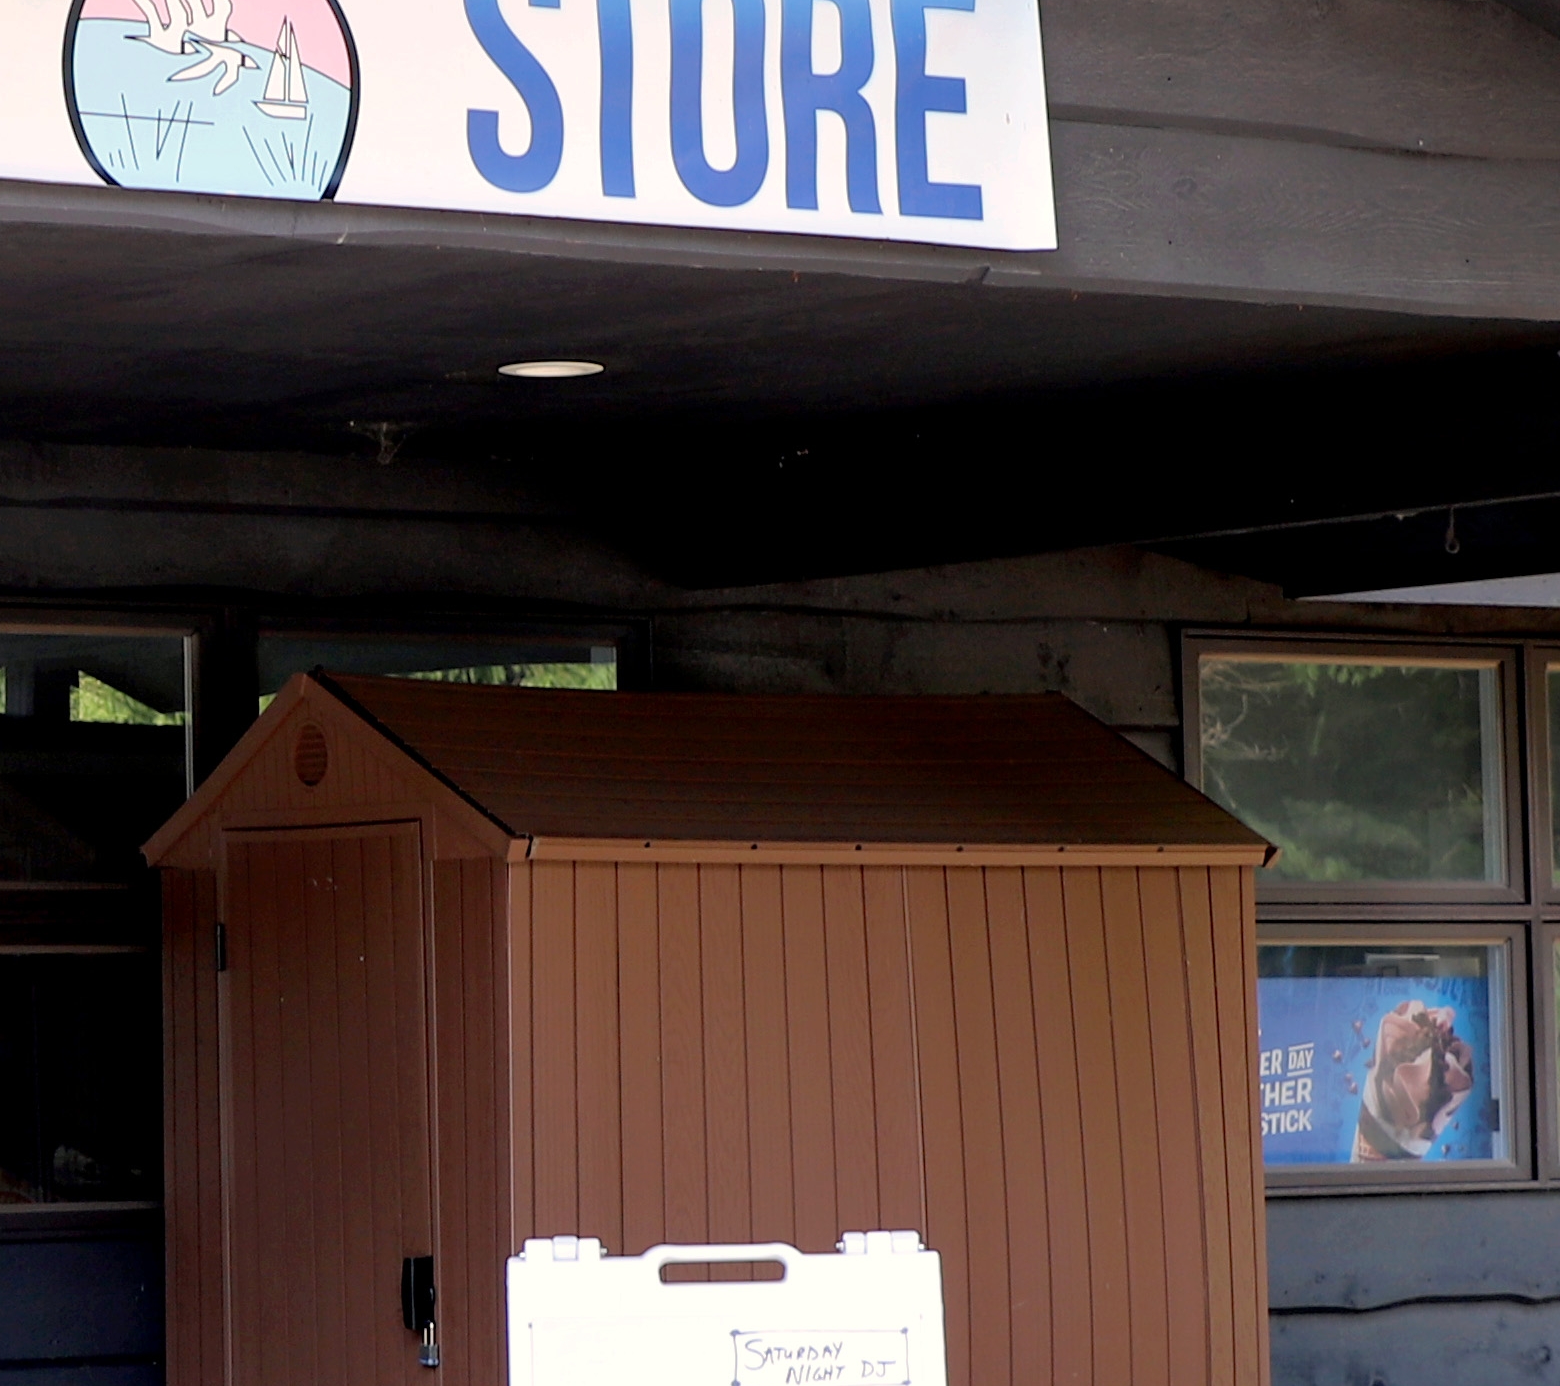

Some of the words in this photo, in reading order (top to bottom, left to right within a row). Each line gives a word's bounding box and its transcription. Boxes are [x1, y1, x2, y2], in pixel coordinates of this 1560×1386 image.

[1260, 1049, 1282, 1077] ER
[1288, 1049, 1314, 1070] DAY
[1261, 1109, 1313, 1137] STICK
[744, 1339, 843, 1370] SATURDAY
[785, 1364, 846, 1385] NIGHT
[861, 1359, 897, 1379] DJ
